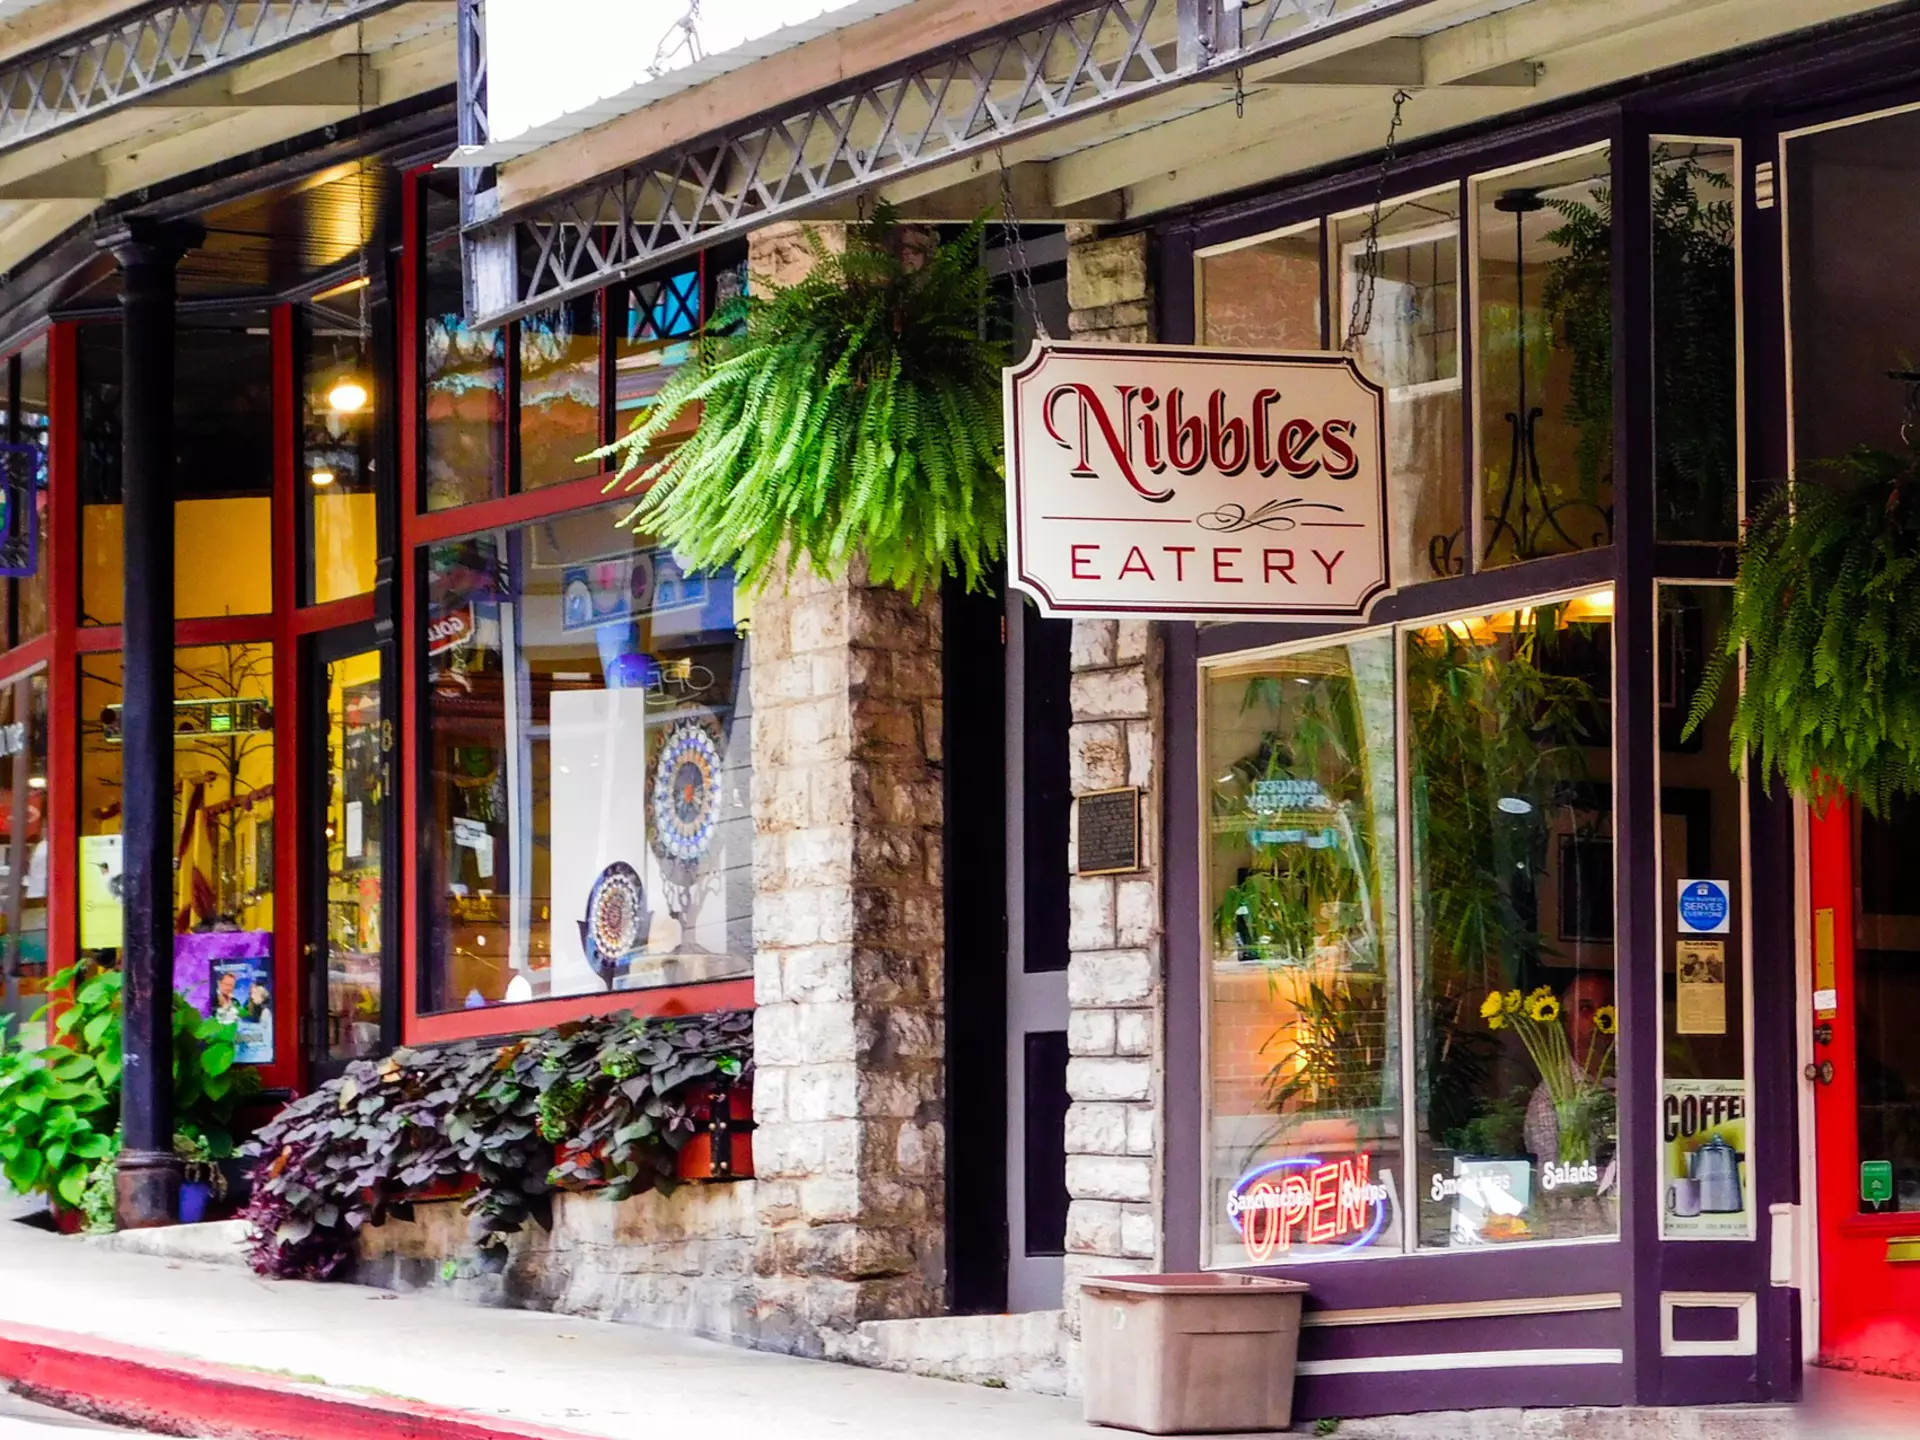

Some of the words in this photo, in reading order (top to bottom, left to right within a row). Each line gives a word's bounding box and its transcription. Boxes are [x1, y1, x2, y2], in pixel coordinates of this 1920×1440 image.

[1043, 382, 1360, 503] Nibbles
[1071, 544, 1345, 585] EATERY
[1683, 902, 1724, 911] SERVES
[1542, 1160, 1598, 1190] Salads
[1243, 1152, 1371, 1262] OPEN
